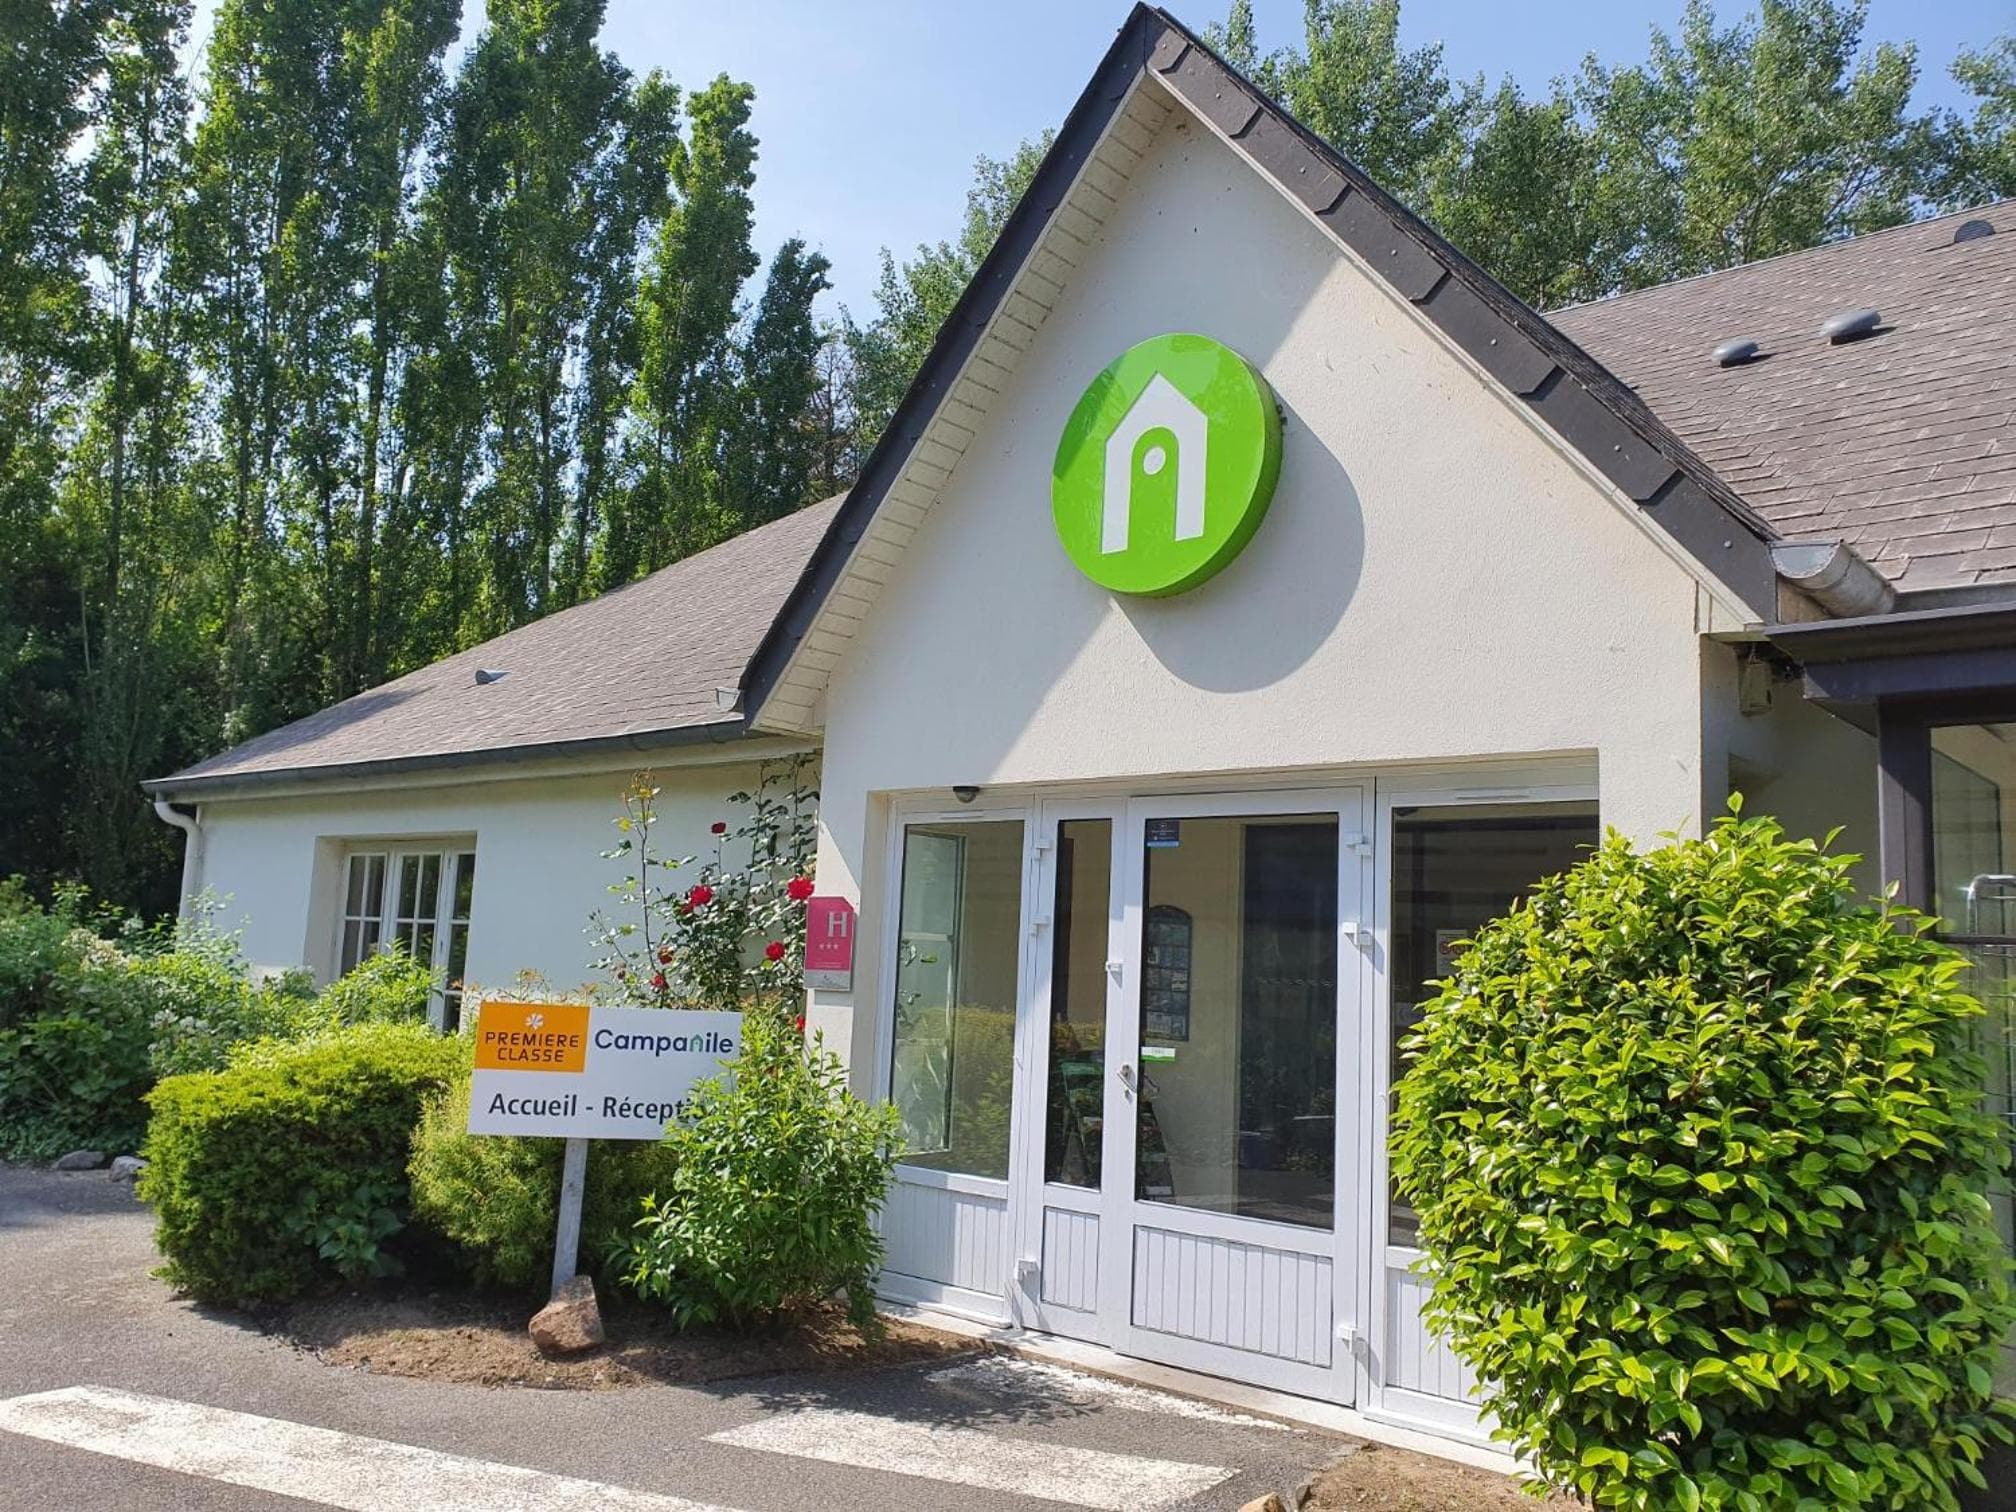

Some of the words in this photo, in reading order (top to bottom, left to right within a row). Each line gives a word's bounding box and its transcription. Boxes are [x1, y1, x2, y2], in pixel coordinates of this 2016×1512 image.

[827, 911, 848, 938] H
[485, 1031, 579, 1048] PREMIERE
[595, 1029, 734, 1057] Campanile
[497, 1047, 564, 1062] CLASSE
[488, 1093, 577, 1117] Accueil
[602, 1096, 707, 1125] Récept
